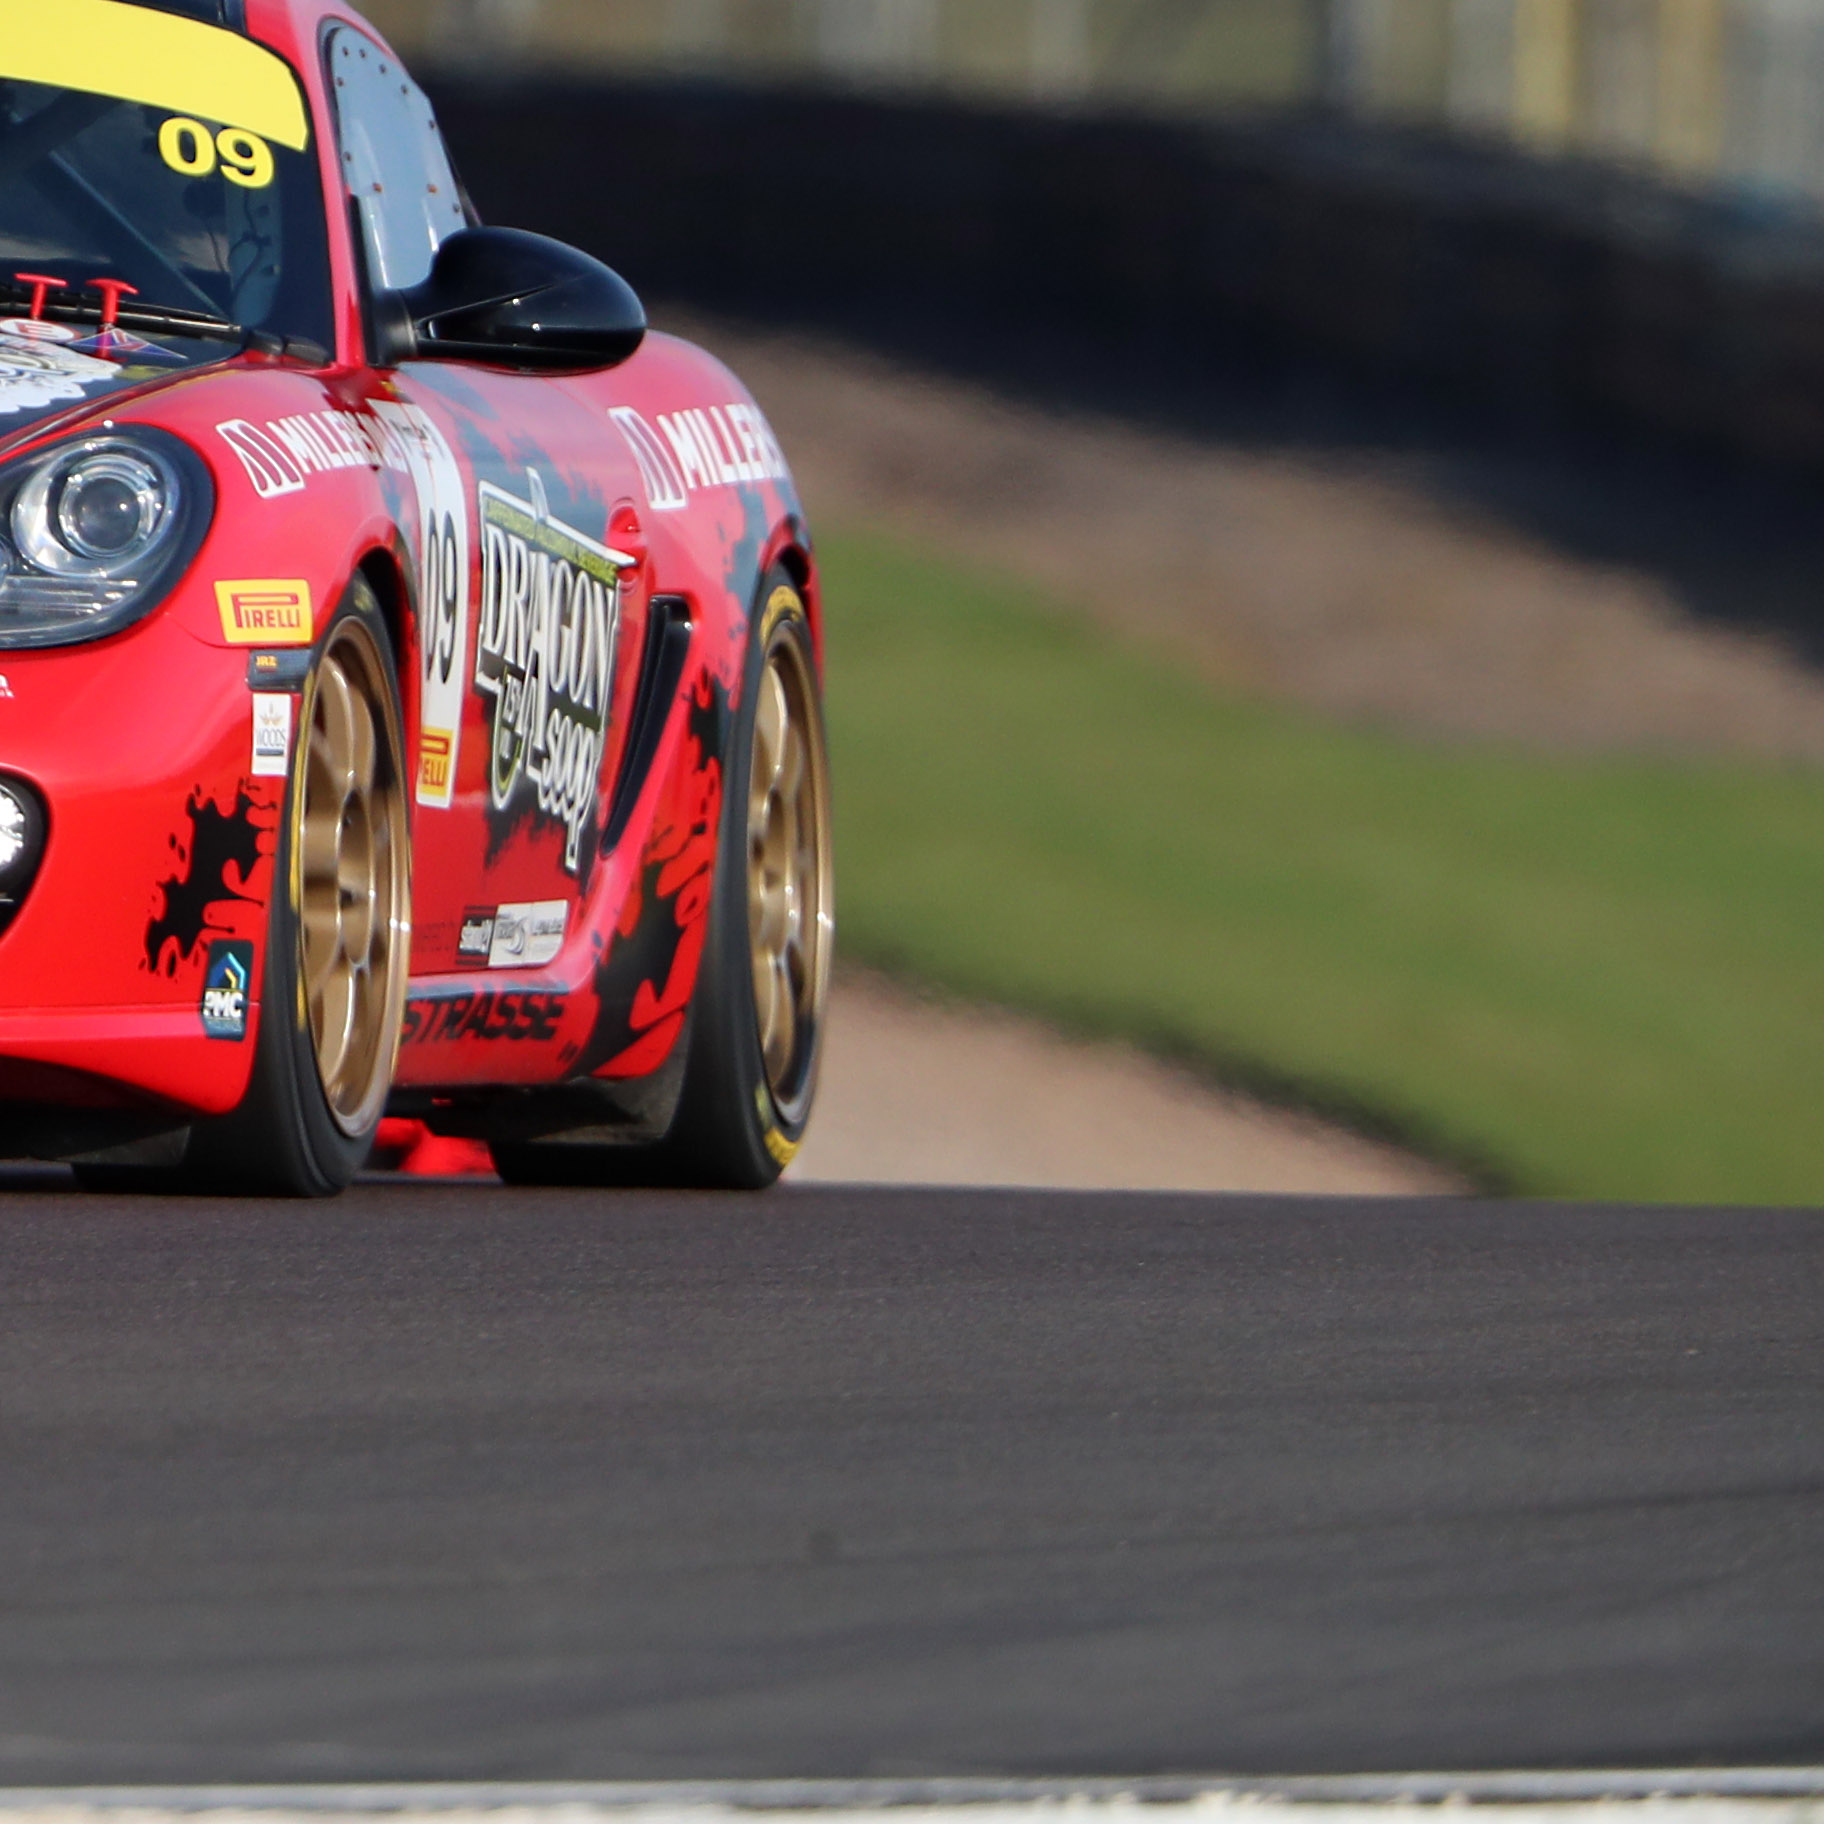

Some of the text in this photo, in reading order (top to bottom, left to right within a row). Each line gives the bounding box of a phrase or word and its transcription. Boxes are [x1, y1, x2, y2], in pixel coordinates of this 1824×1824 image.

[158, 117, 274, 189] 09
[231, 592, 301, 628] PIRELLI
[427, 508, 458, 684] 09
[483, 522, 618, 751] DRAGON
